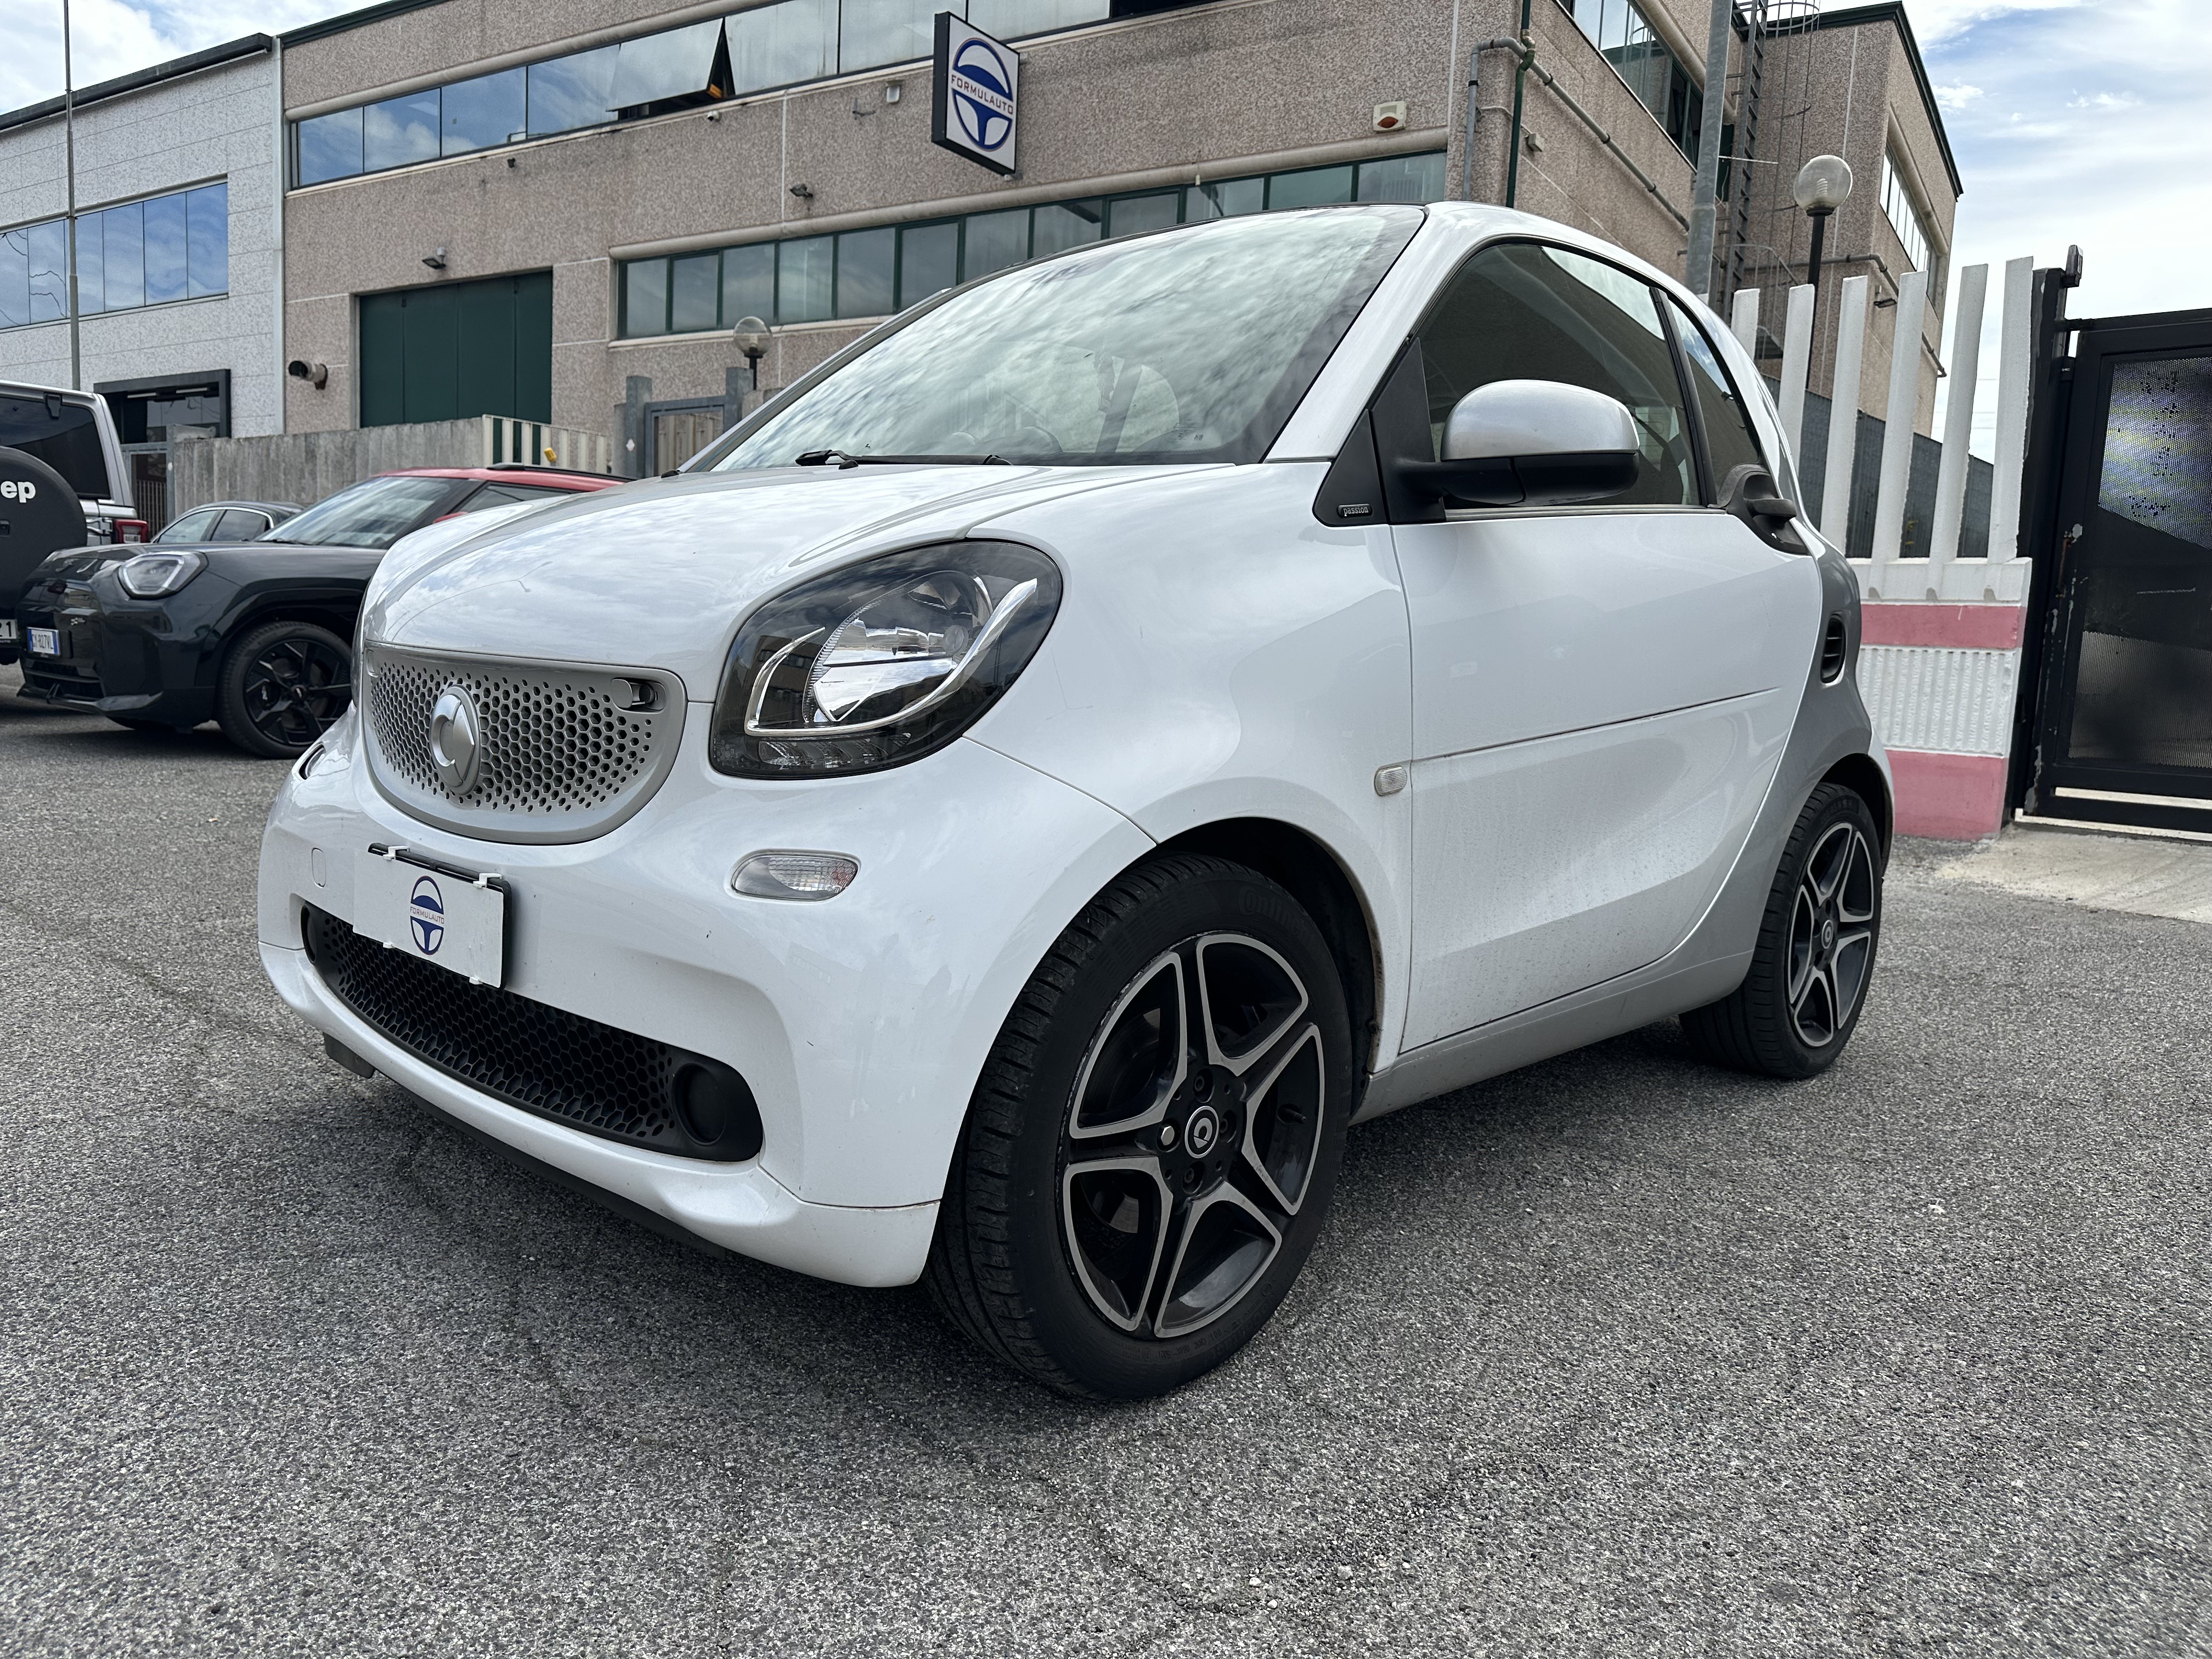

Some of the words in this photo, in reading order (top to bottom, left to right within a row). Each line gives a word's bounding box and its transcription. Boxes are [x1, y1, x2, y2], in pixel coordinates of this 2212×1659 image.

[951, 74, 1014, 115] FORMULAUTO
[0, 481, 36, 503] ep
[1343, 505, 1369, 517] passion
[410, 906, 444, 924] FORMULAUTO
